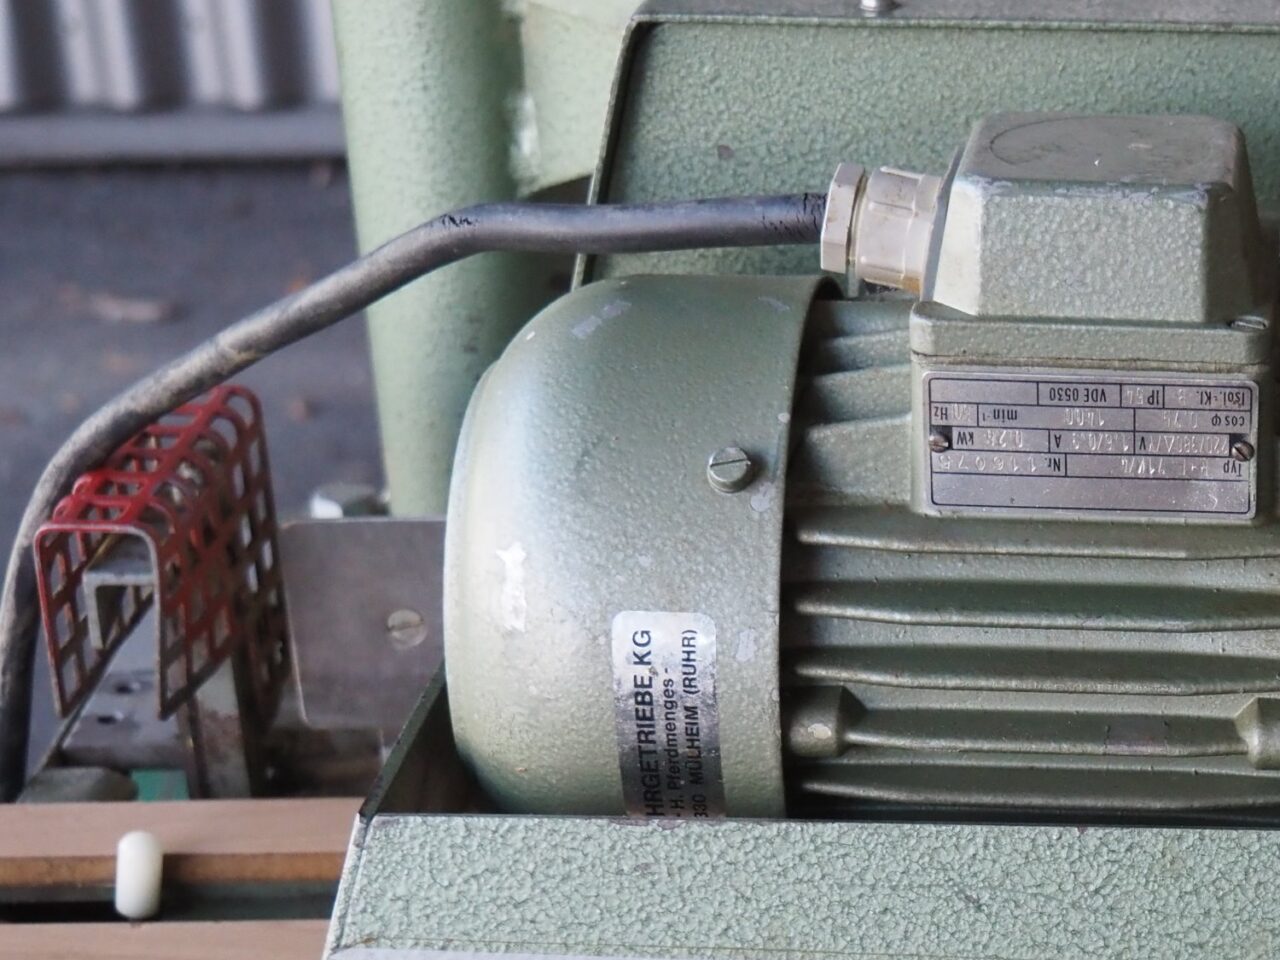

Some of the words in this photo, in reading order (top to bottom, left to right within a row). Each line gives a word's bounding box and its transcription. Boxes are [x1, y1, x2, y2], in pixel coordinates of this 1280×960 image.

[1049, 387, 1078, 401] 0530
[1083, 389, 1107, 402] VDE
[1147, 389, 1159, 405] IP
[934, 406, 948, 419] Hz
[1225, 417, 1245, 427] cos
[956, 431, 974, 445] kW
[1054, 435, 1061, 448] A
[1139, 436, 1146, 450] V
[1044, 457, 1061, 472] Nr.
[1223, 461, 1242, 477] Typ
[632, 629, 653, 666] KG
[681, 629, 701, 695] (RUHR)
[662, 678, 681, 792] Pferdmenges
[683, 704, 705, 786] MÜLHEIM
